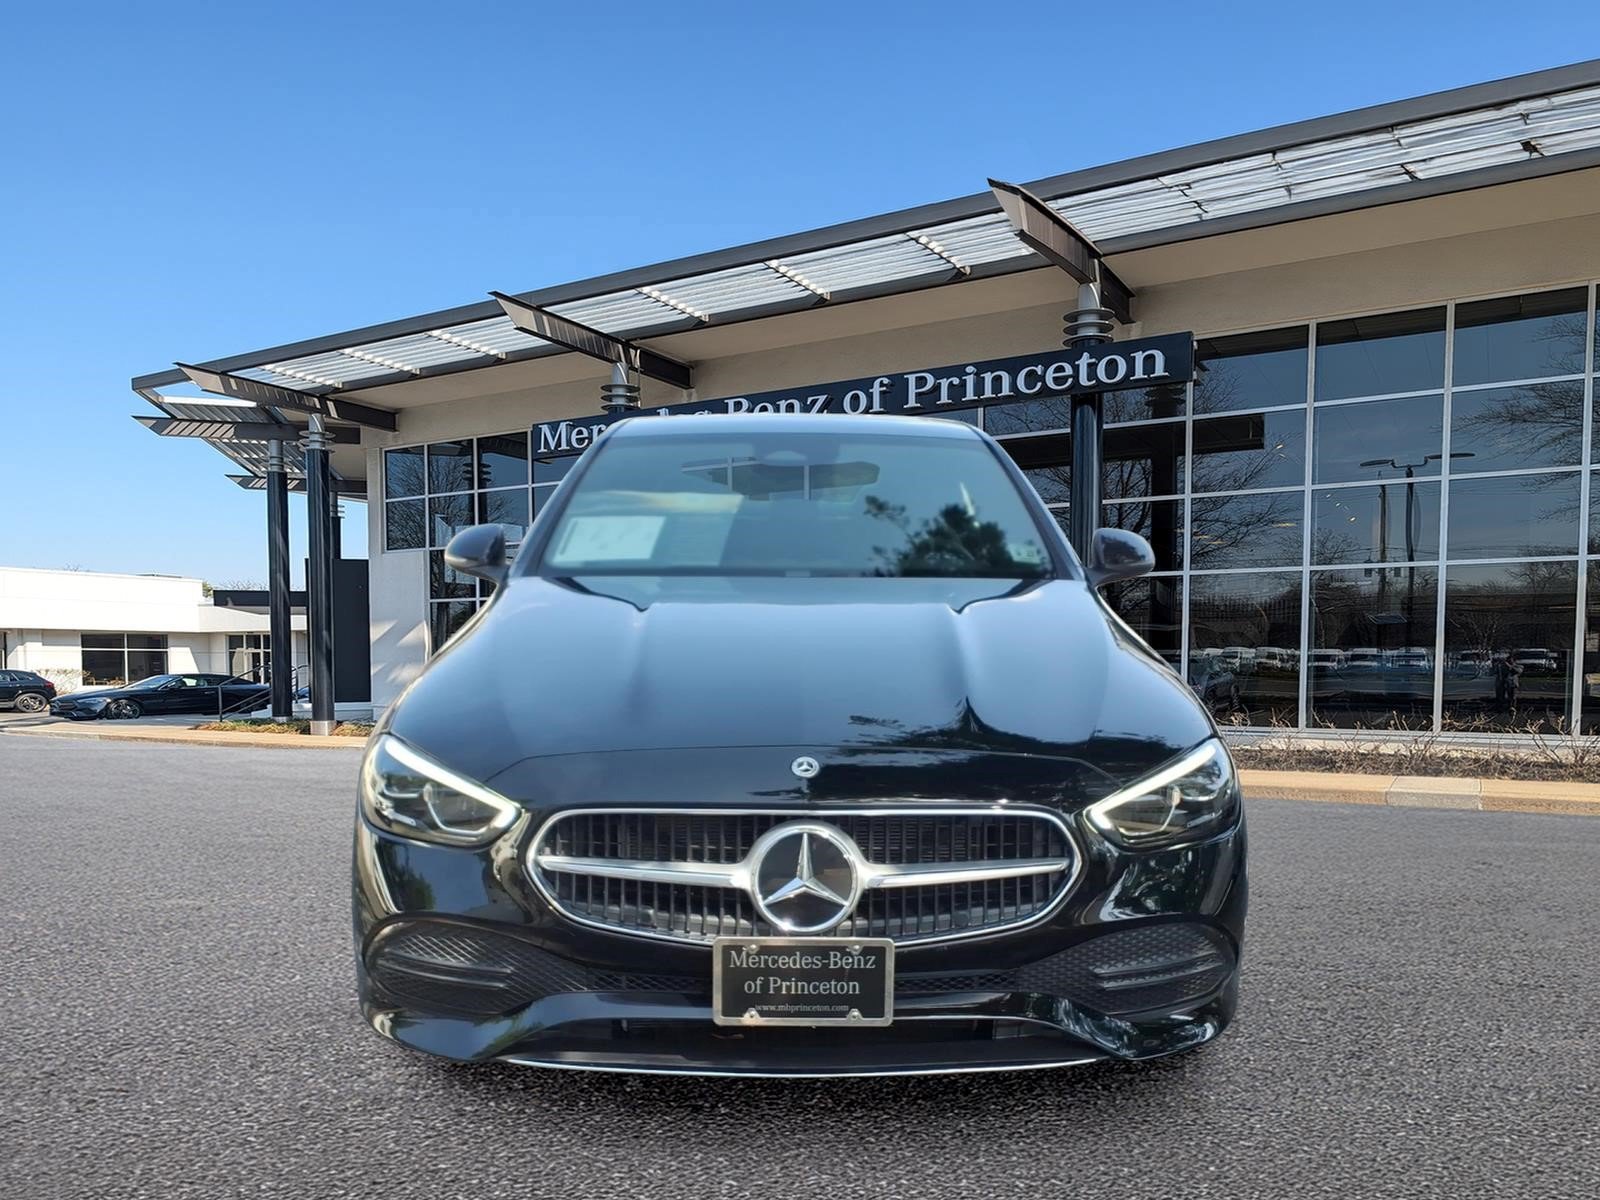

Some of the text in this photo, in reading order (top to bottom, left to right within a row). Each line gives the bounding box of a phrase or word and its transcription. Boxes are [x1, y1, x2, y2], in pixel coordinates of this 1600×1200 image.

[843, 377, 891, 415] of
[903, 348, 1170, 408] Princeton
[729, 951, 876, 969] Mercedes-Benz
[744, 976, 860, 994] of Princeton
[755, 1003, 849, 1014] www.mbprinceton.com
